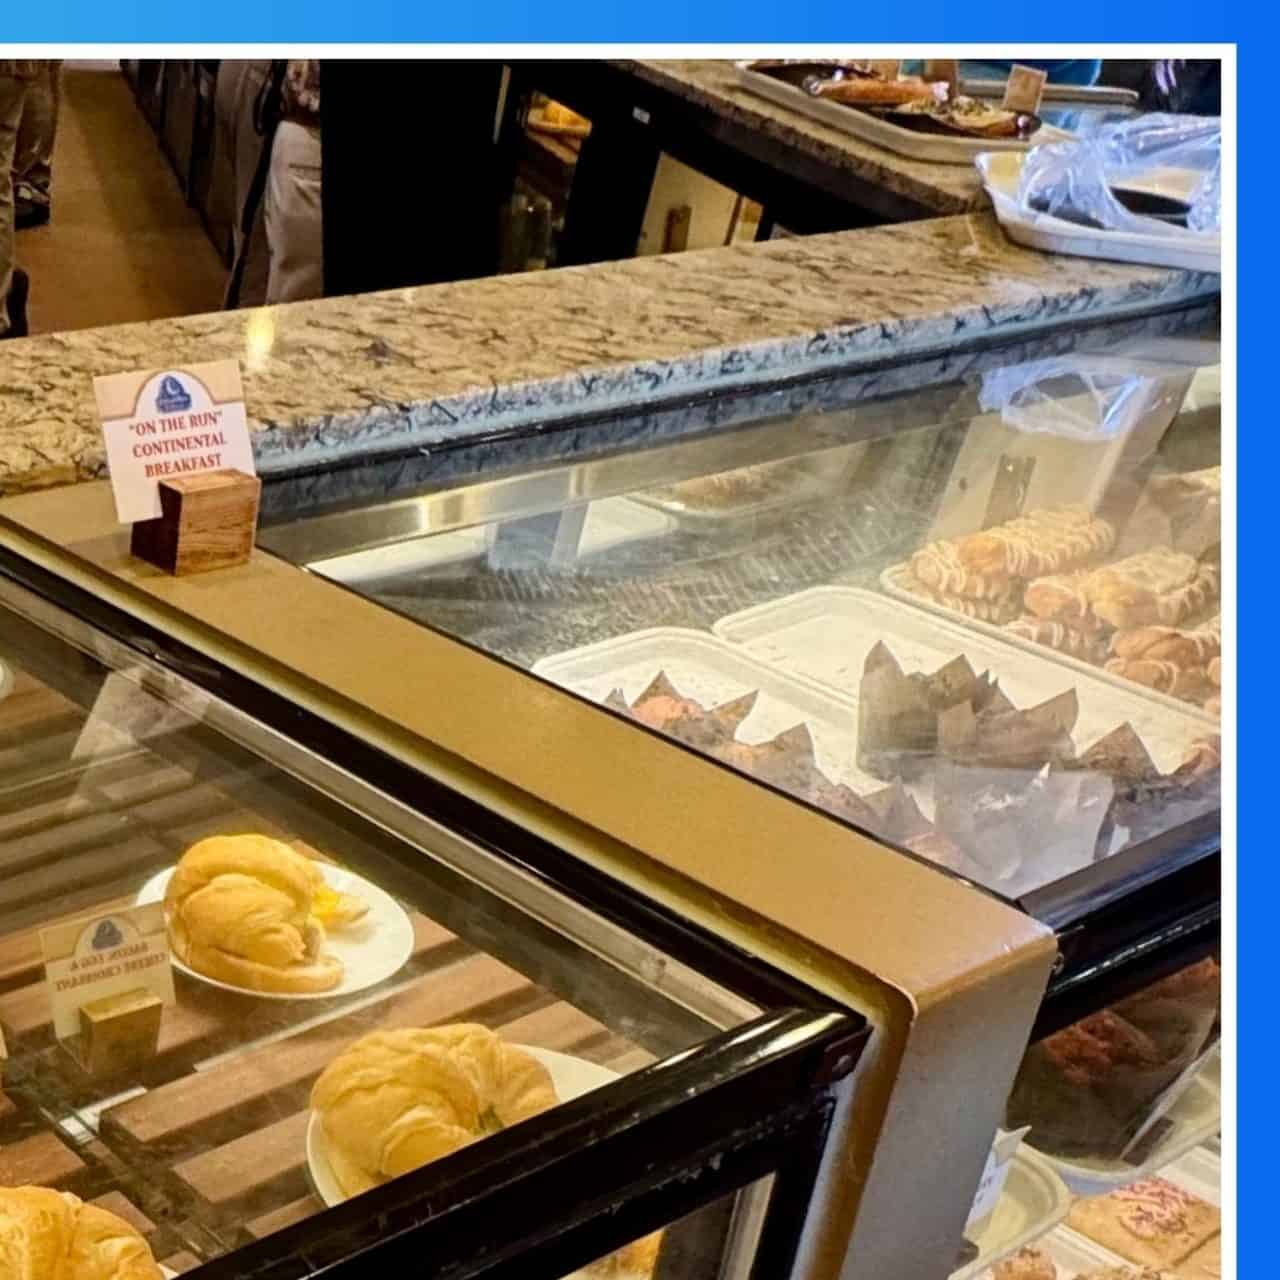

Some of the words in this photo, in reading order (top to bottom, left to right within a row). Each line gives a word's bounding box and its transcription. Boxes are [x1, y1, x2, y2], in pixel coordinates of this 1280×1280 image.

[159, 416, 187, 433] THE
[132, 431, 228, 458] CONTINENTAL
[144, 453, 223, 478] BREAKFAST
